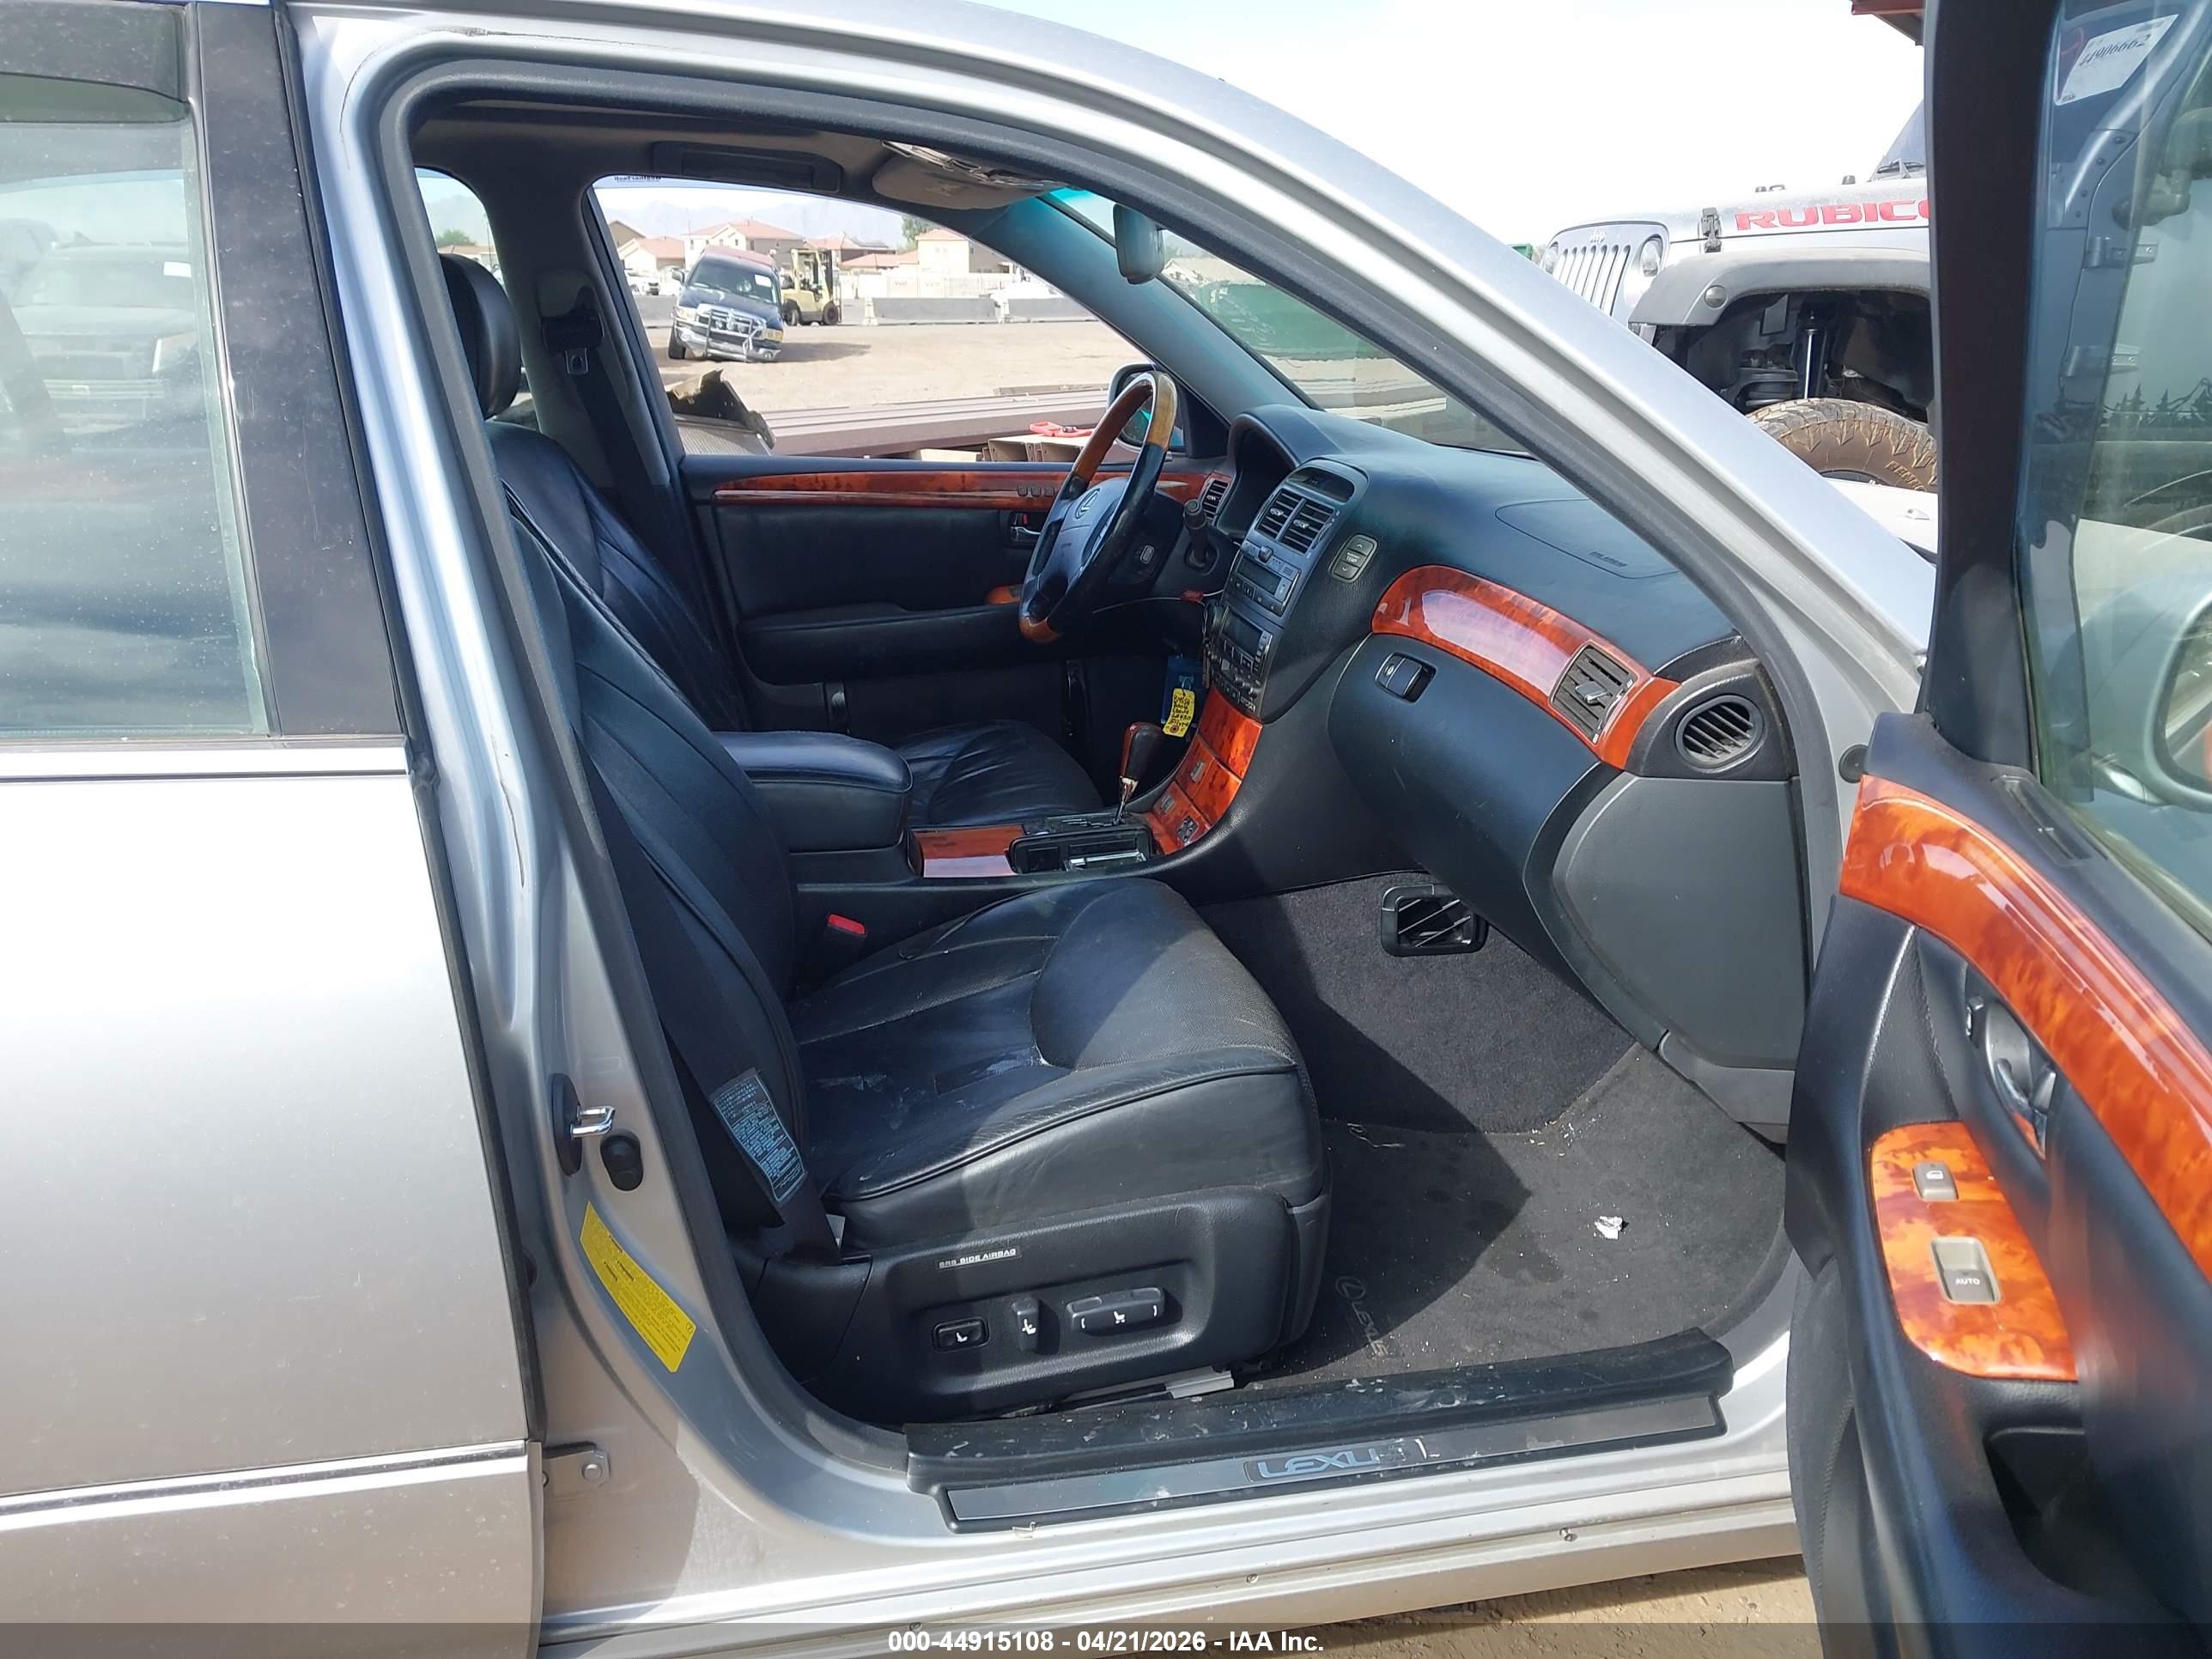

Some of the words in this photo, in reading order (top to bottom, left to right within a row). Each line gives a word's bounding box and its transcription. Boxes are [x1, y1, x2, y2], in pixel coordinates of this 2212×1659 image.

[960, 1255, 981, 1264] SIDE
[981, 1248, 1017, 1261] AIRBAG
[1955, 1277, 1980, 1285] AUTO
[1257, 1443, 1395, 1478] LEXU
